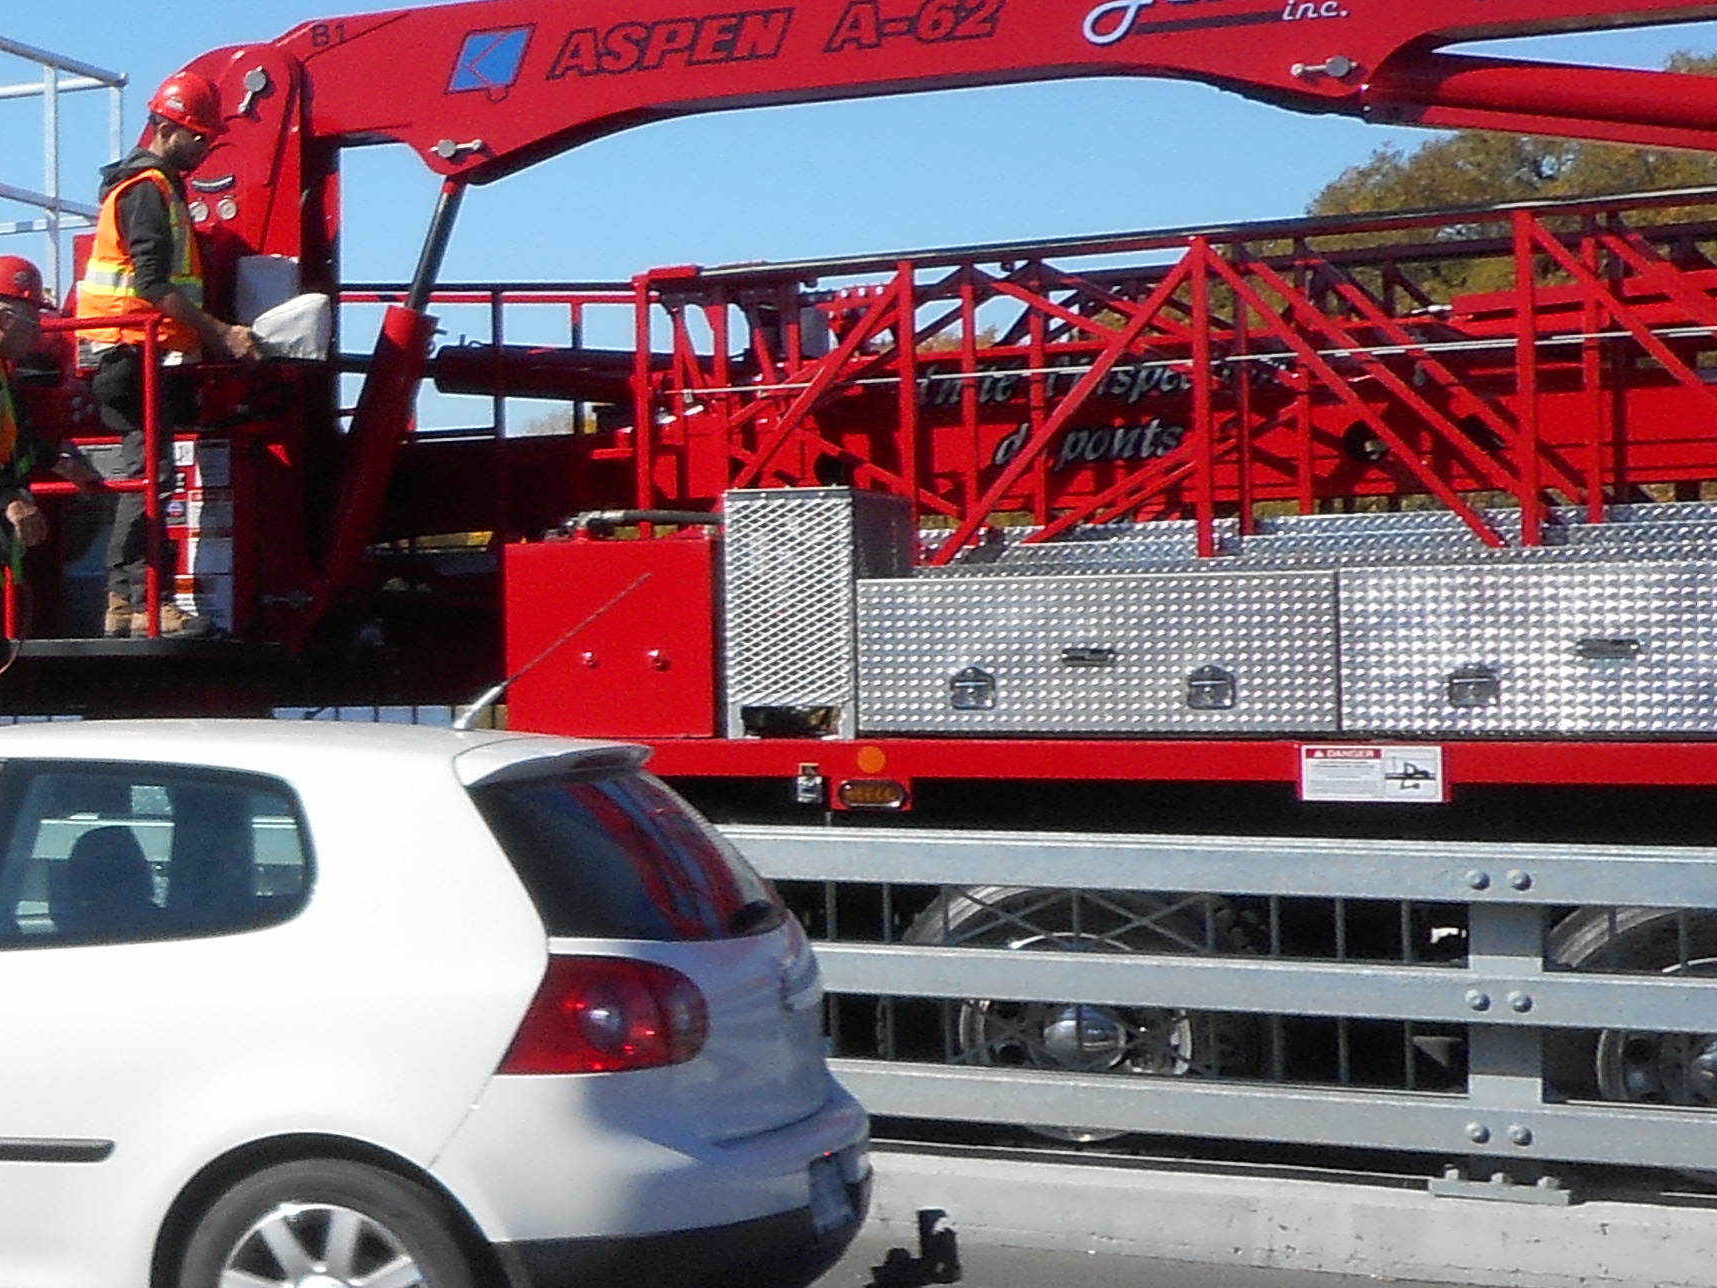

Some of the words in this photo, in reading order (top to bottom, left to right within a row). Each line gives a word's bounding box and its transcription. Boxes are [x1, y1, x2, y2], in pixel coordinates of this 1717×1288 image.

[312, 22, 347, 48] B1
[546, 6, 795, 82] ASPEN
[1054, 418, 1185, 472] ponts
[1326, 749, 1375, 758] DANGER
